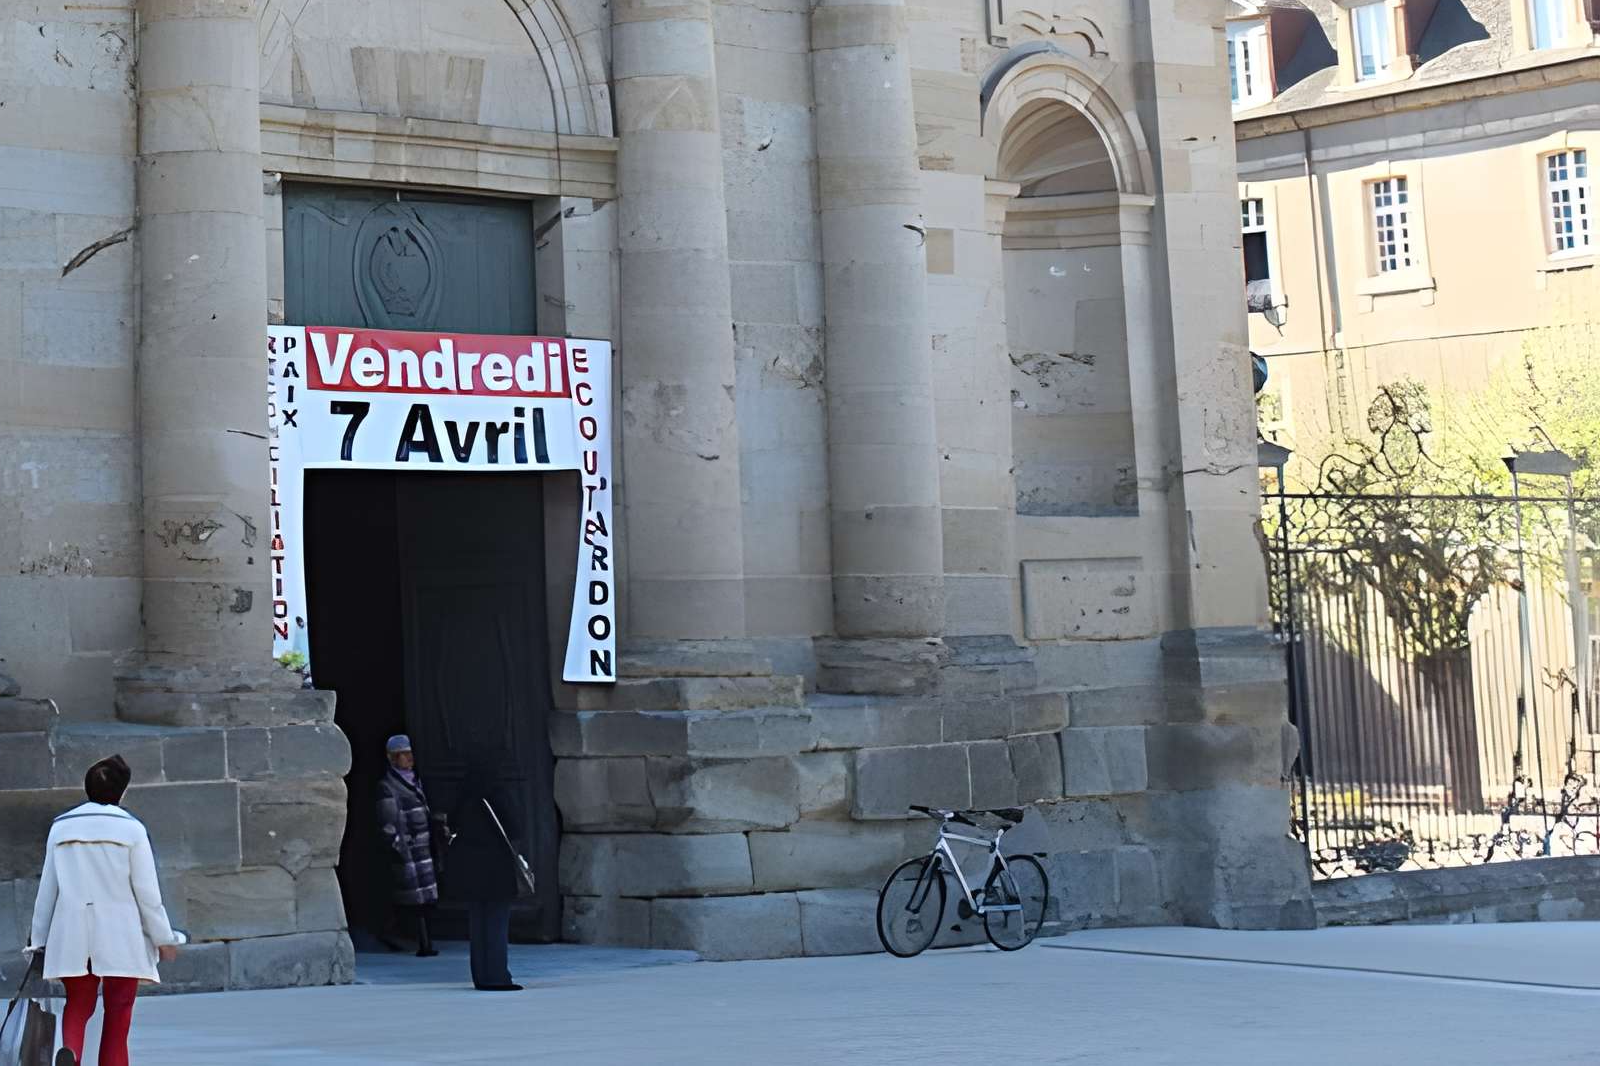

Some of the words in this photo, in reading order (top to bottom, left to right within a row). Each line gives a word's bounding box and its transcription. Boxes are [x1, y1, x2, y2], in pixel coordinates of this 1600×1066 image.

[282, 336, 300, 428] PAIX
[309, 331, 565, 393] Vendredi
[329, 400, 371, 462] 7
[394, 403, 551, 464] Avril
